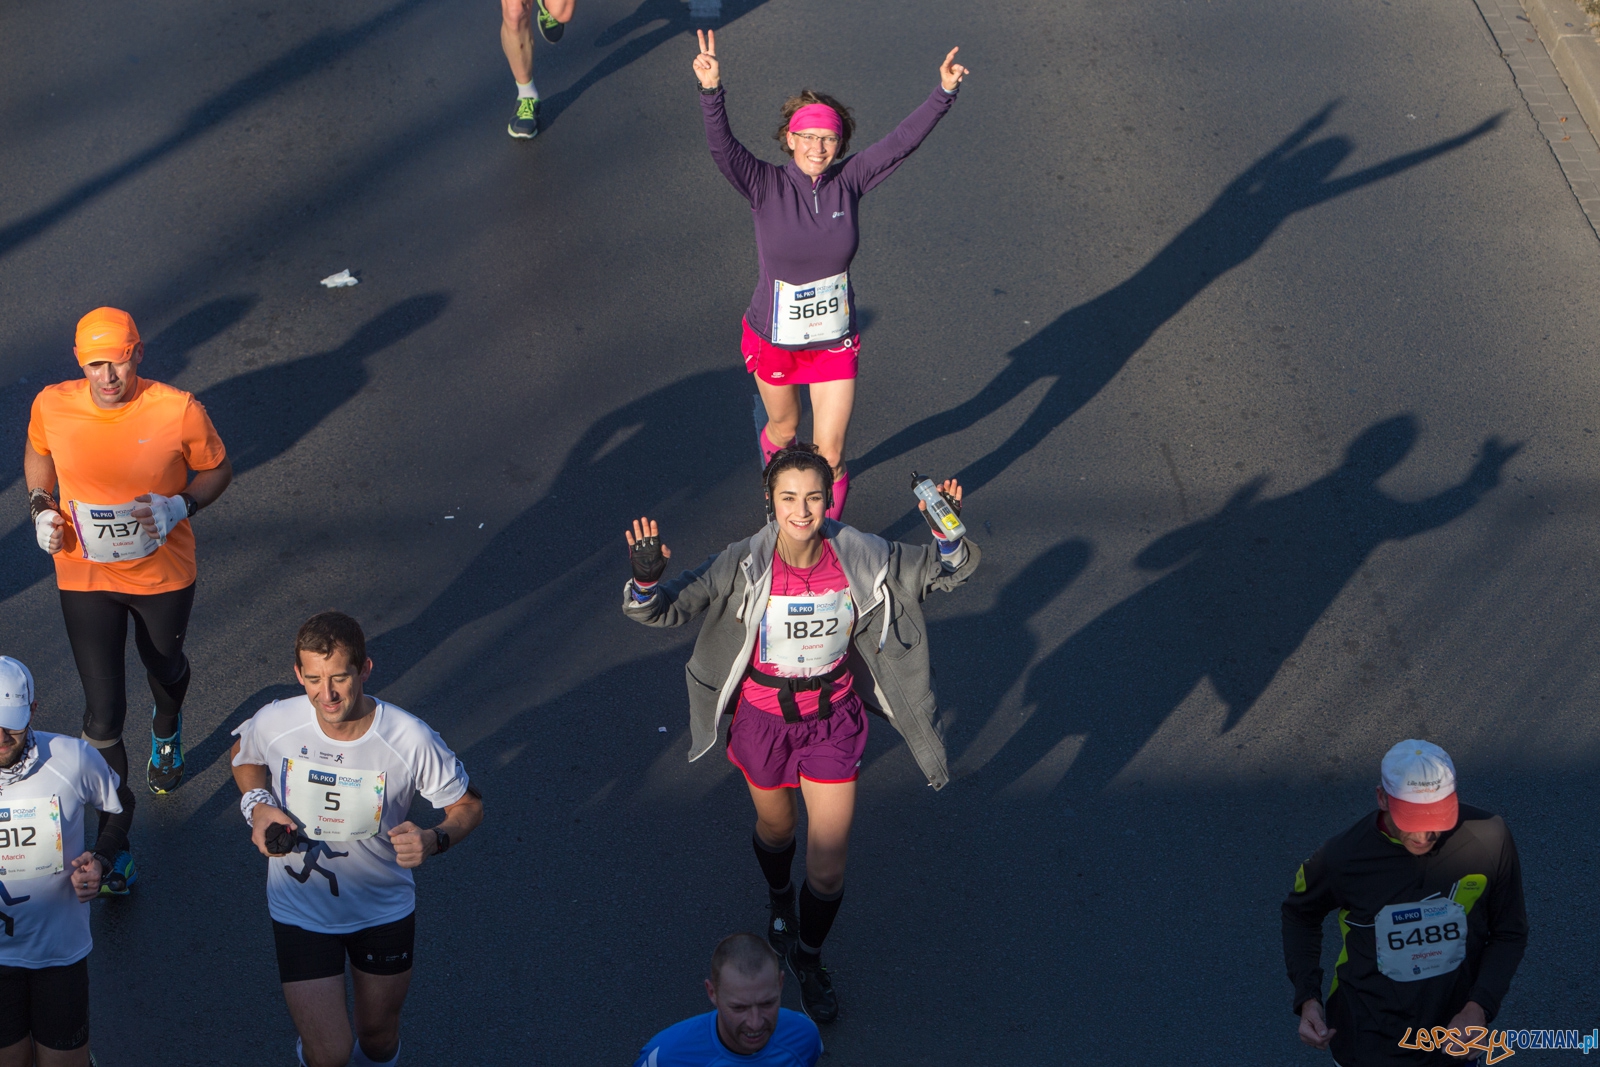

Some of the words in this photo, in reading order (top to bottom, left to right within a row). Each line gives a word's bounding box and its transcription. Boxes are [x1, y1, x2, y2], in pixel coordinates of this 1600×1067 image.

[789, 297, 838, 320] 3669
[93, 520, 140, 538] 7137
[785, 618, 838, 639] 1822
[311, 773, 319, 781] 16.
[321, 775, 334, 783] PKO
[324, 791, 341, 811] 5
[318, 815, 345, 823] Tomasz
[1405, 912, 1419, 920] PKO
[1387, 922, 1460, 950] 6488
[1412, 950, 1442, 960] Zbigniew
